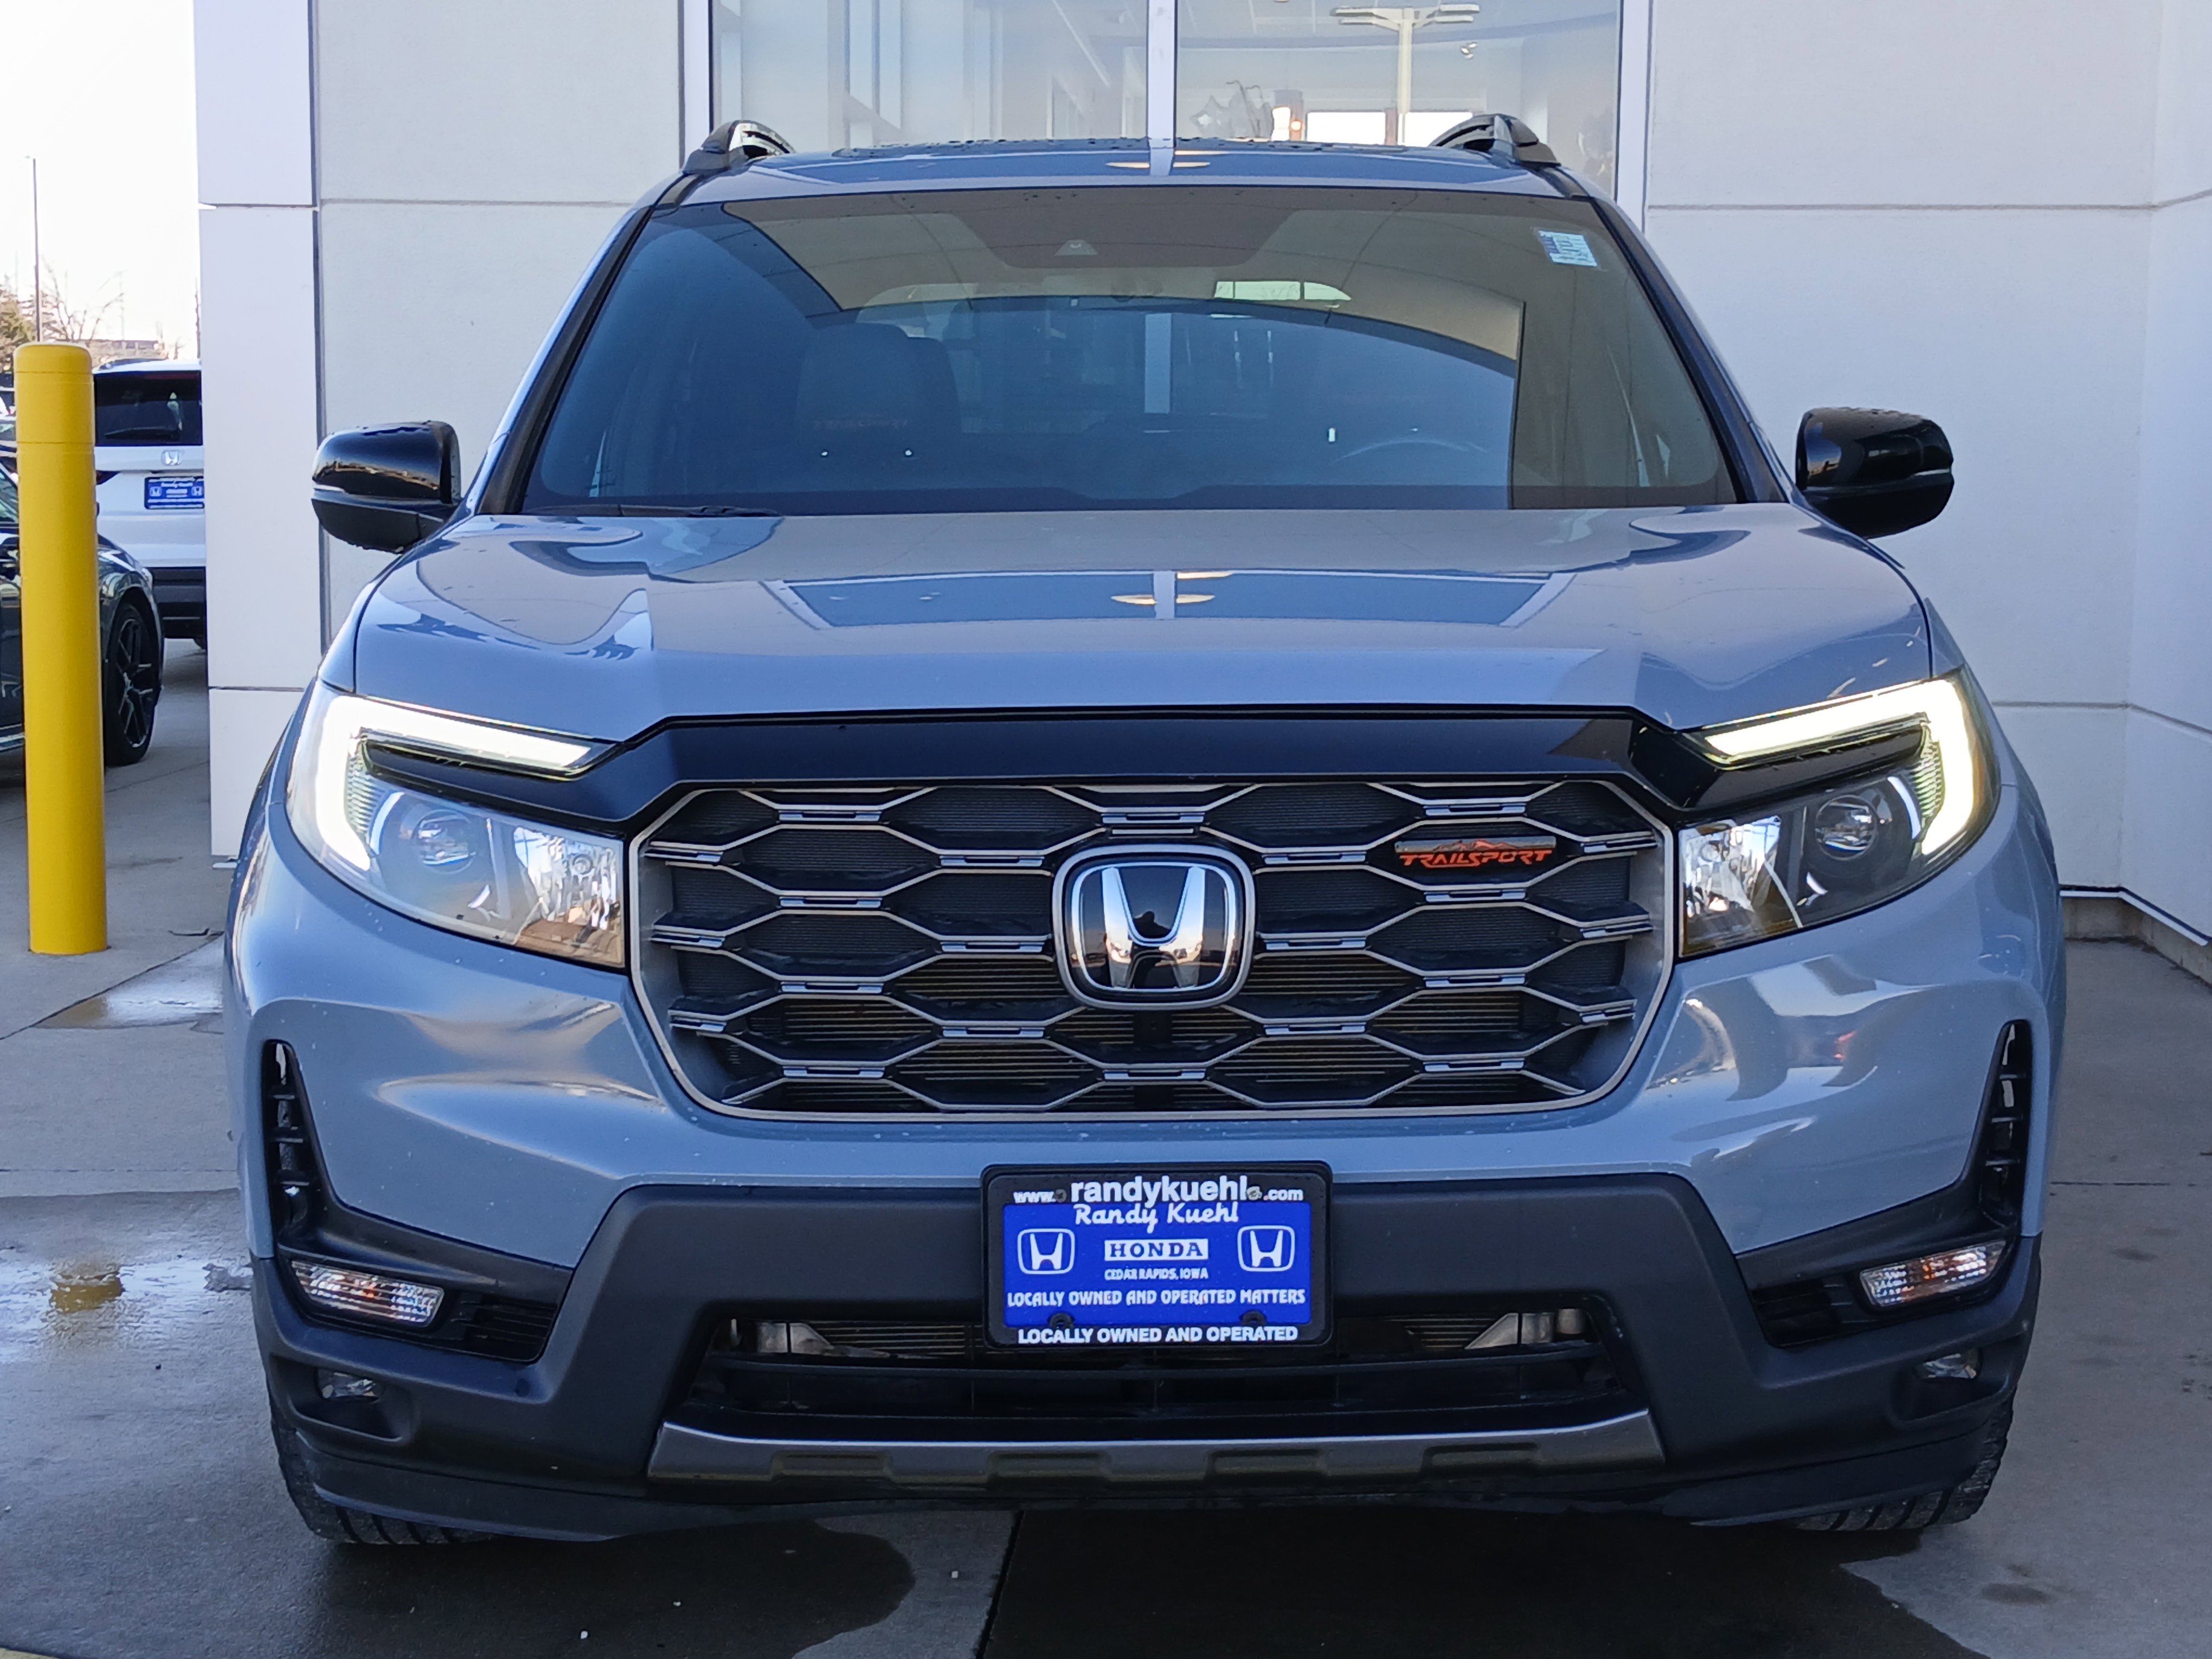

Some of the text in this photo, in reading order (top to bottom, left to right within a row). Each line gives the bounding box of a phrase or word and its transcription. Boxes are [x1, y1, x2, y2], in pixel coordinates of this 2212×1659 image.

[1399, 849, 1553, 869] TRAILSPORT
[1070, 1175, 1248, 1209] randykuehl
[1073, 1201, 1239, 1234] Randy Kuehl
[1109, 1242, 1203, 1258] HONDA
[1104, 1268, 1138, 1281] CEDAR
[1179, 1267, 1209, 1280] IOWA
[1007, 1289, 1307, 1307] LOCALLY OWNED AND OPERATED MATTERS
[1018, 1326, 1298, 1345] LOCALLY OWNED AND OPERATED
